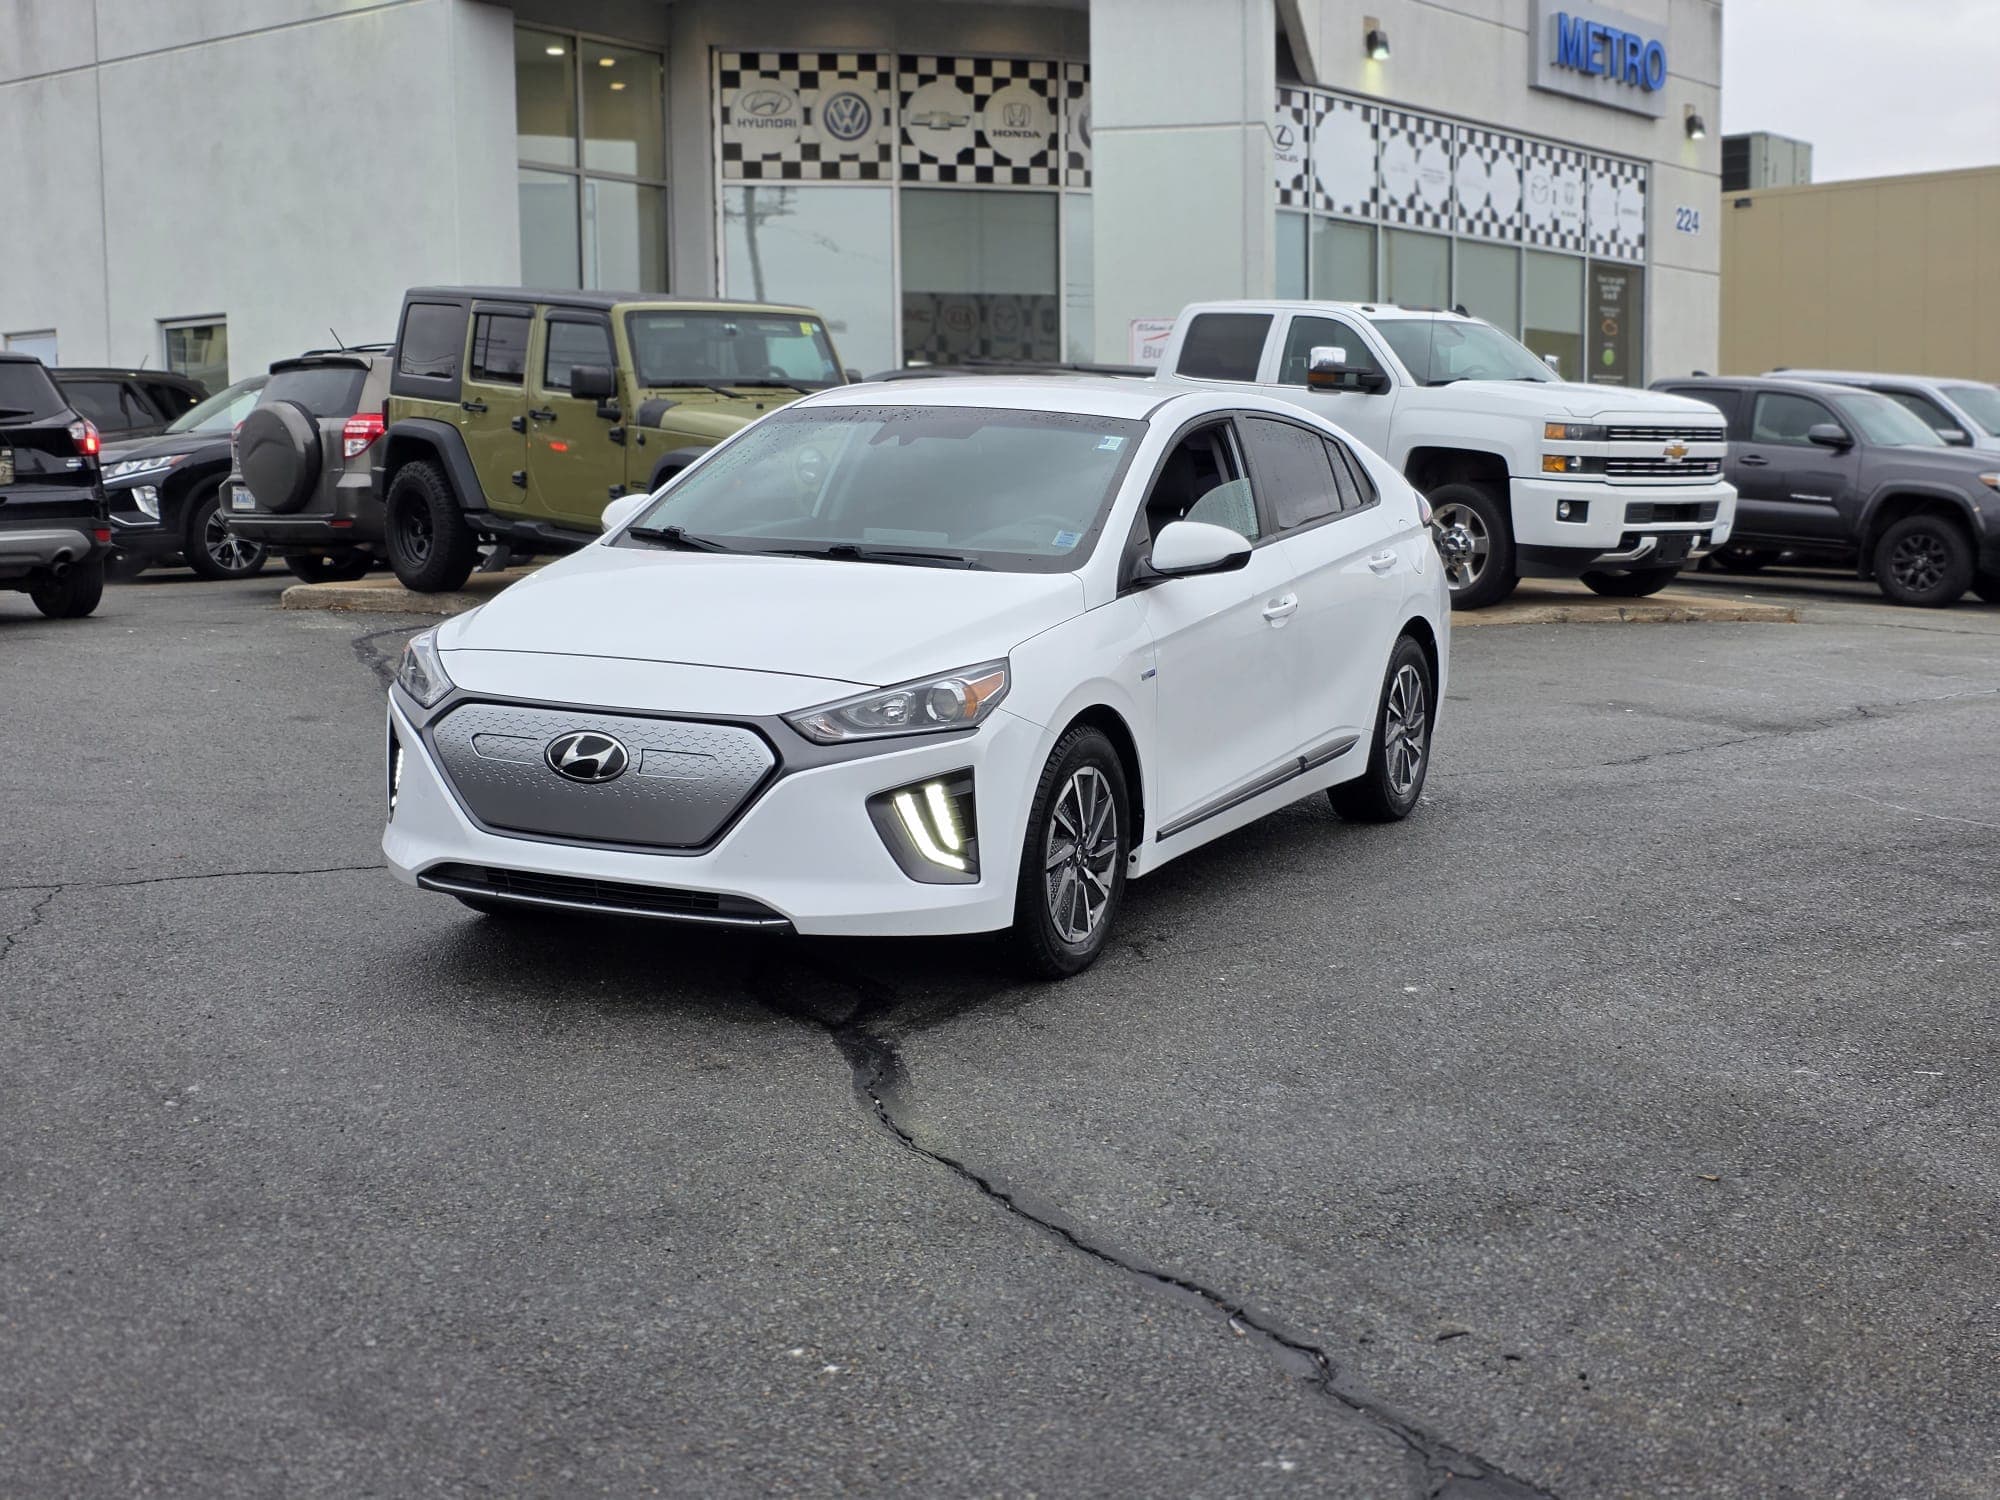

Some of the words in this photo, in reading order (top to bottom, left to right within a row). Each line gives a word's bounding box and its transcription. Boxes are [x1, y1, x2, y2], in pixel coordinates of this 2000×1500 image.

[1558, 12, 1667, 91] METRO
[737, 118, 797, 128] HYUNDAI
[992, 129, 1042, 139] HONDA
[1676, 207, 1699, 233] 224
